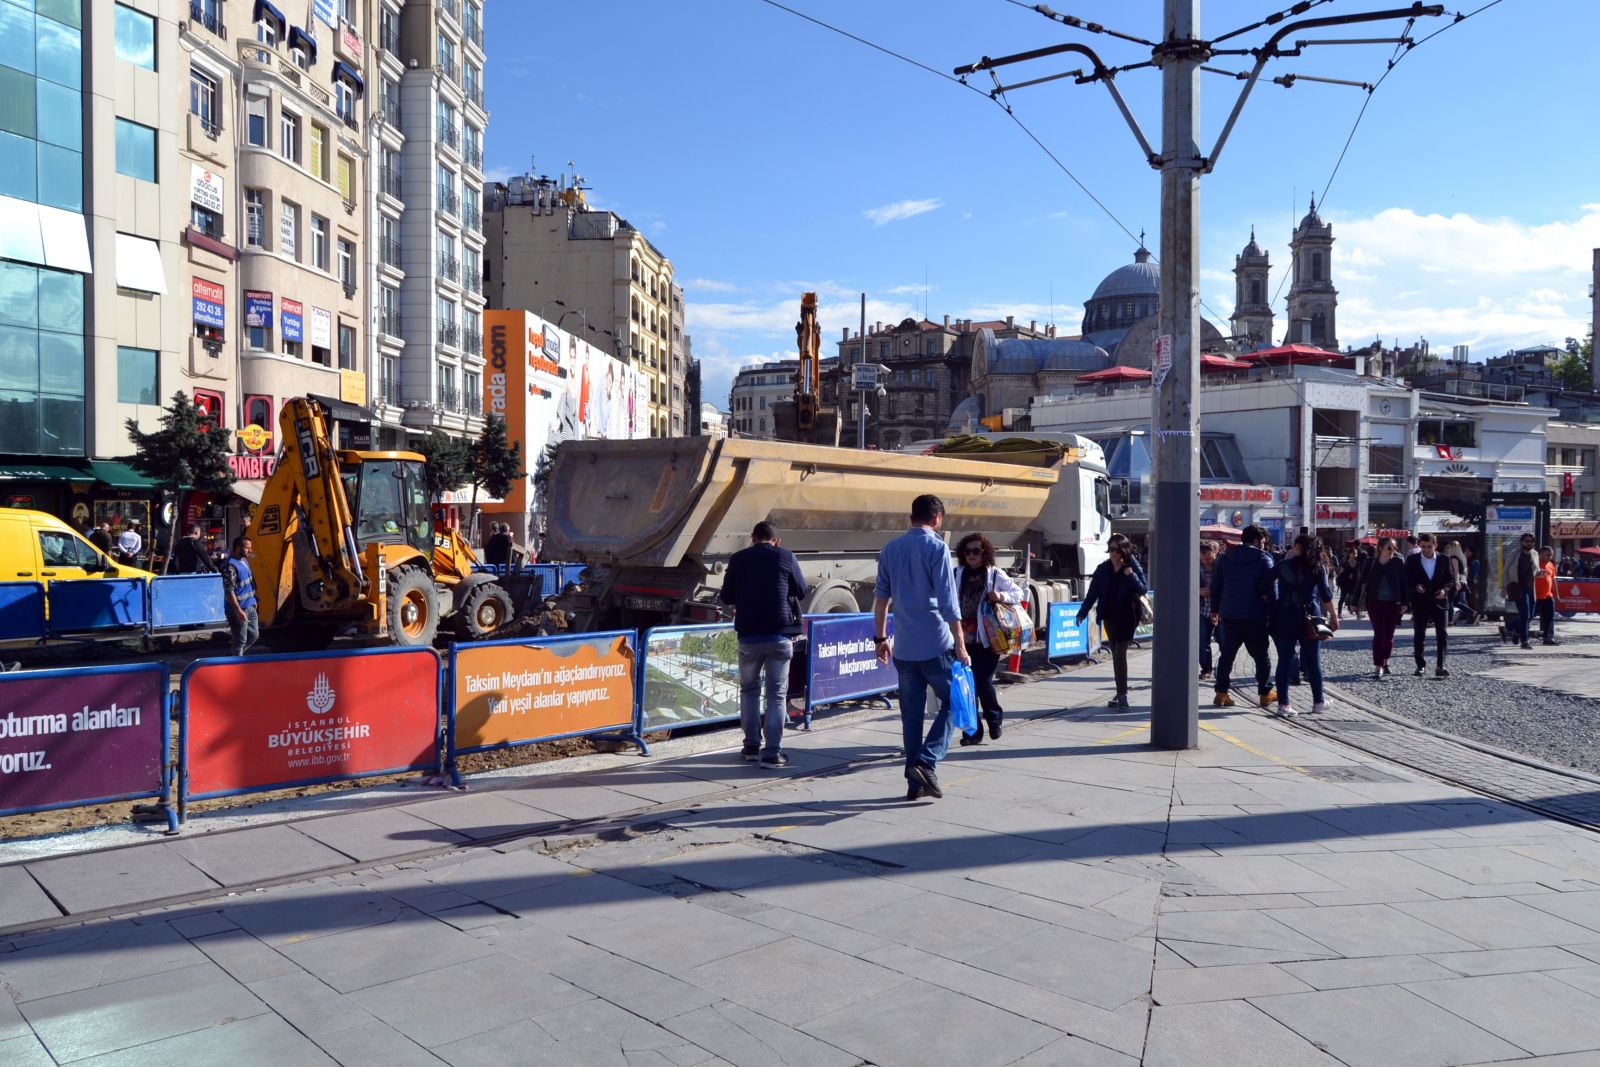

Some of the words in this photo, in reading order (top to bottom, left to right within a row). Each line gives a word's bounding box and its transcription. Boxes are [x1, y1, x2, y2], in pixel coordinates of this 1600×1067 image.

[197, 178, 218, 194] abacus
[193, 282, 224, 300] alternatif
[196, 301, 207, 313] 292
[207, 304, 214, 315] 43
[282, 300, 302, 313] alternatif
[1244, 489, 1273, 501] KING
[264, 506, 280, 532] JCB
[378, 554, 387, 593] JCB
[818, 641, 837, 659] Taksim
[465, 673, 500, 694] Taksim
[502, 668, 553, 693] Meydanı'nı
[554, 663, 627, 688] ağaçlandırıyoruz.
[487, 696, 508, 715] Yeni
[510, 692, 532, 716] yeşil
[534, 690, 564, 709] alanlar
[567, 687, 610, 709] yapıyoruz.
[72, 703, 141, 732] alanları
[288, 716, 351, 730] İSTANBUL
[268, 722, 370, 748] BÜYÜKŞEHİR
[288, 743, 351, 757] BELEDİYESİ
[287, 753, 351, 769] www.ibb.gov.tr
